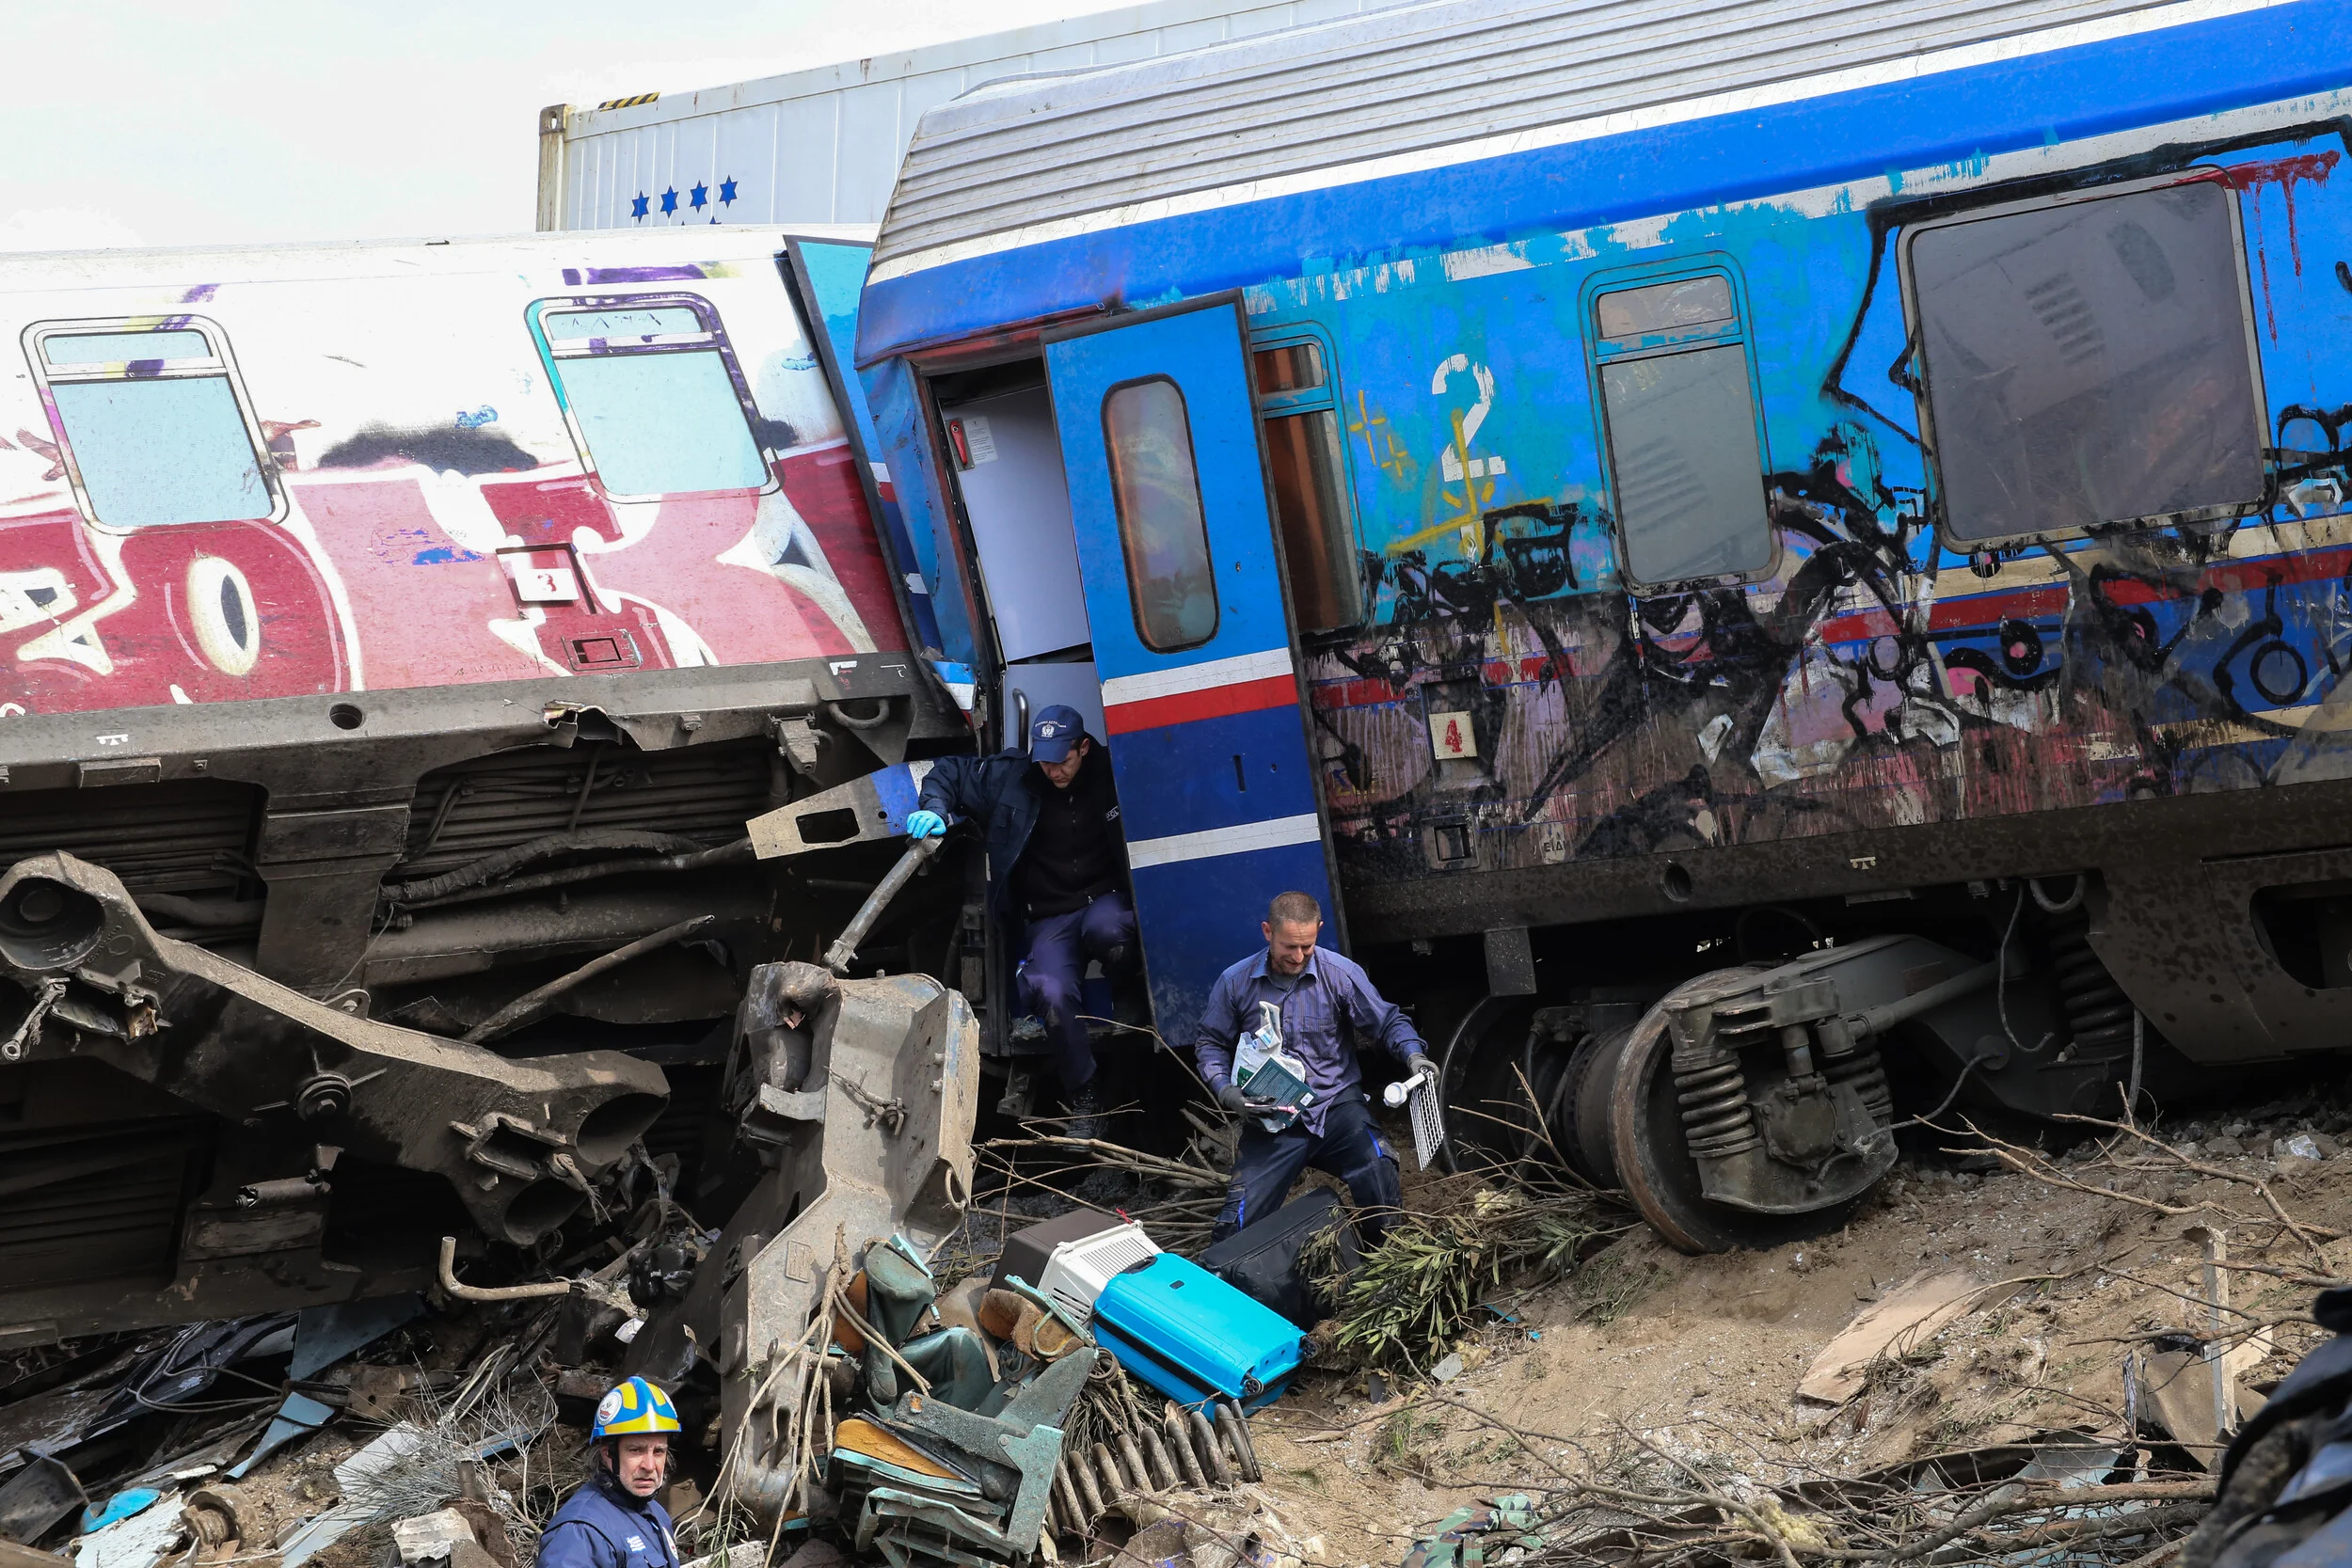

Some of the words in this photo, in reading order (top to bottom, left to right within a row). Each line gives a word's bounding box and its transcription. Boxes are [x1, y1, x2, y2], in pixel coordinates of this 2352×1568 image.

[1432, 353, 1507, 483] 2
[1444, 719, 1463, 753] 4
[1105, 808, 1120, 819] POL
